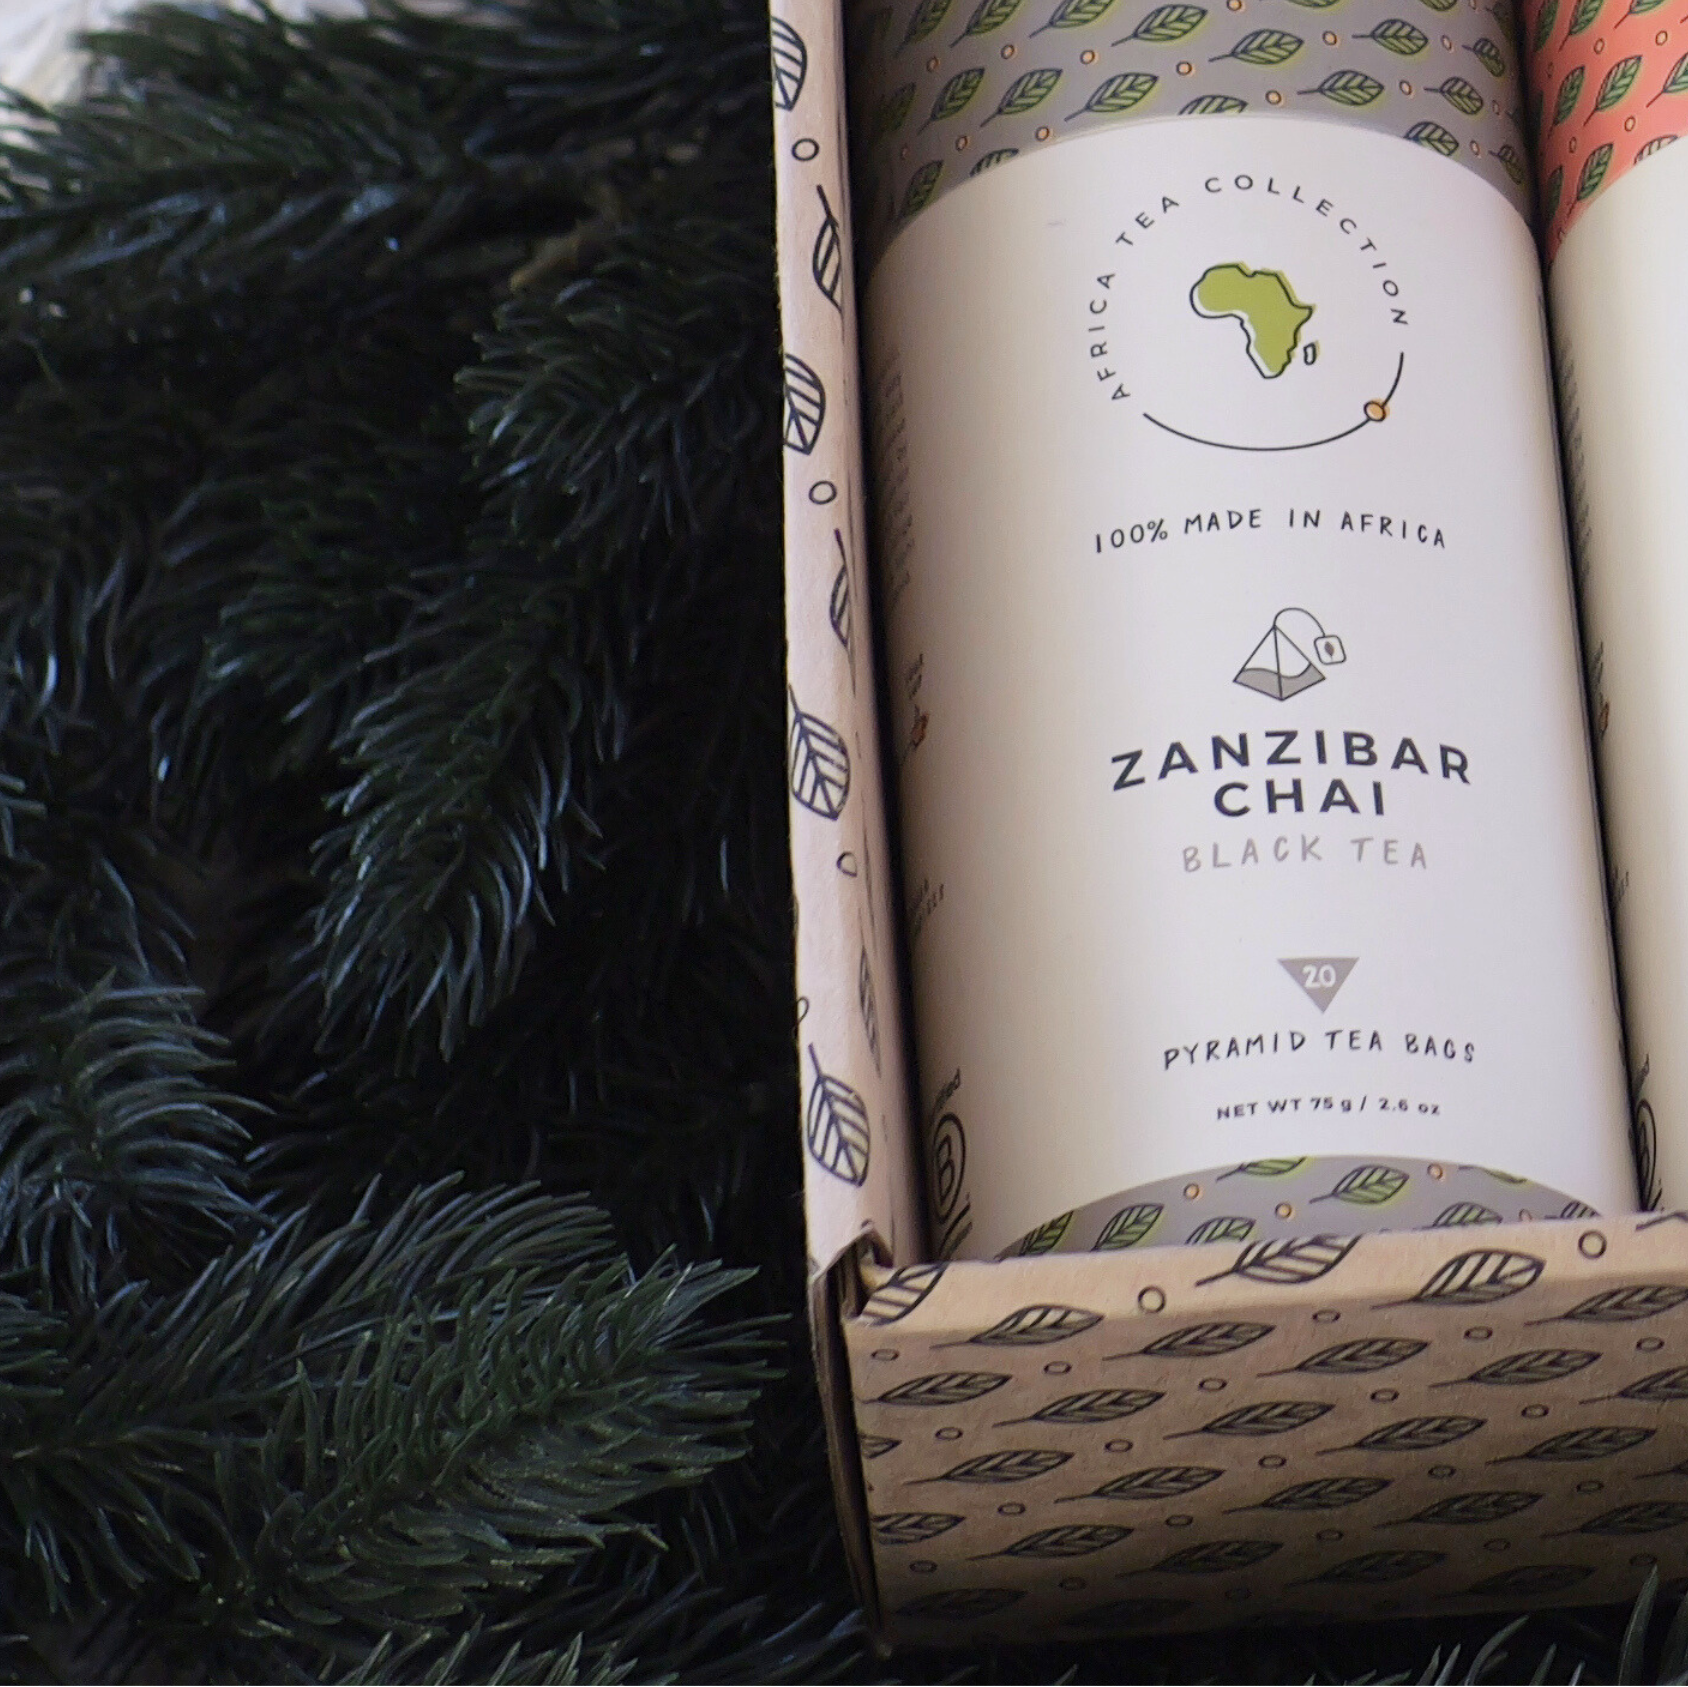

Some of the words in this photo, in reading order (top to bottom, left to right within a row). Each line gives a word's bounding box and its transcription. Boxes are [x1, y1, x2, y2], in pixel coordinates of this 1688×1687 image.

[1088, 273, 1131, 401] AFRICA
[1115, 196, 1180, 246] TEA
[1204, 174, 1409, 325] COLLECTION
[1095, 517, 1169, 554] 100%
[1184, 508, 1262, 535] MADE
[1289, 508, 1321, 528] IN
[1340, 511, 1445, 549] AFRICA
[1111, 729, 1470, 792] ZANZIBAR
[1213, 778, 1385, 818] CHAI
[1182, 833, 1323, 873] BLACK
[1350, 836, 1427, 870] TEA
[1302, 964, 1336, 989] 20
[1163, 1031, 1306, 1071] PYRAMID
[1325, 1029, 1382, 1051] TEA
[1404, 1033, 1475, 1063] BAGS
[1216, 1102, 1259, 1120] NET
[1267, 1098, 1301, 1114] WT
[1417, 1103, 1439, 1115] oz
